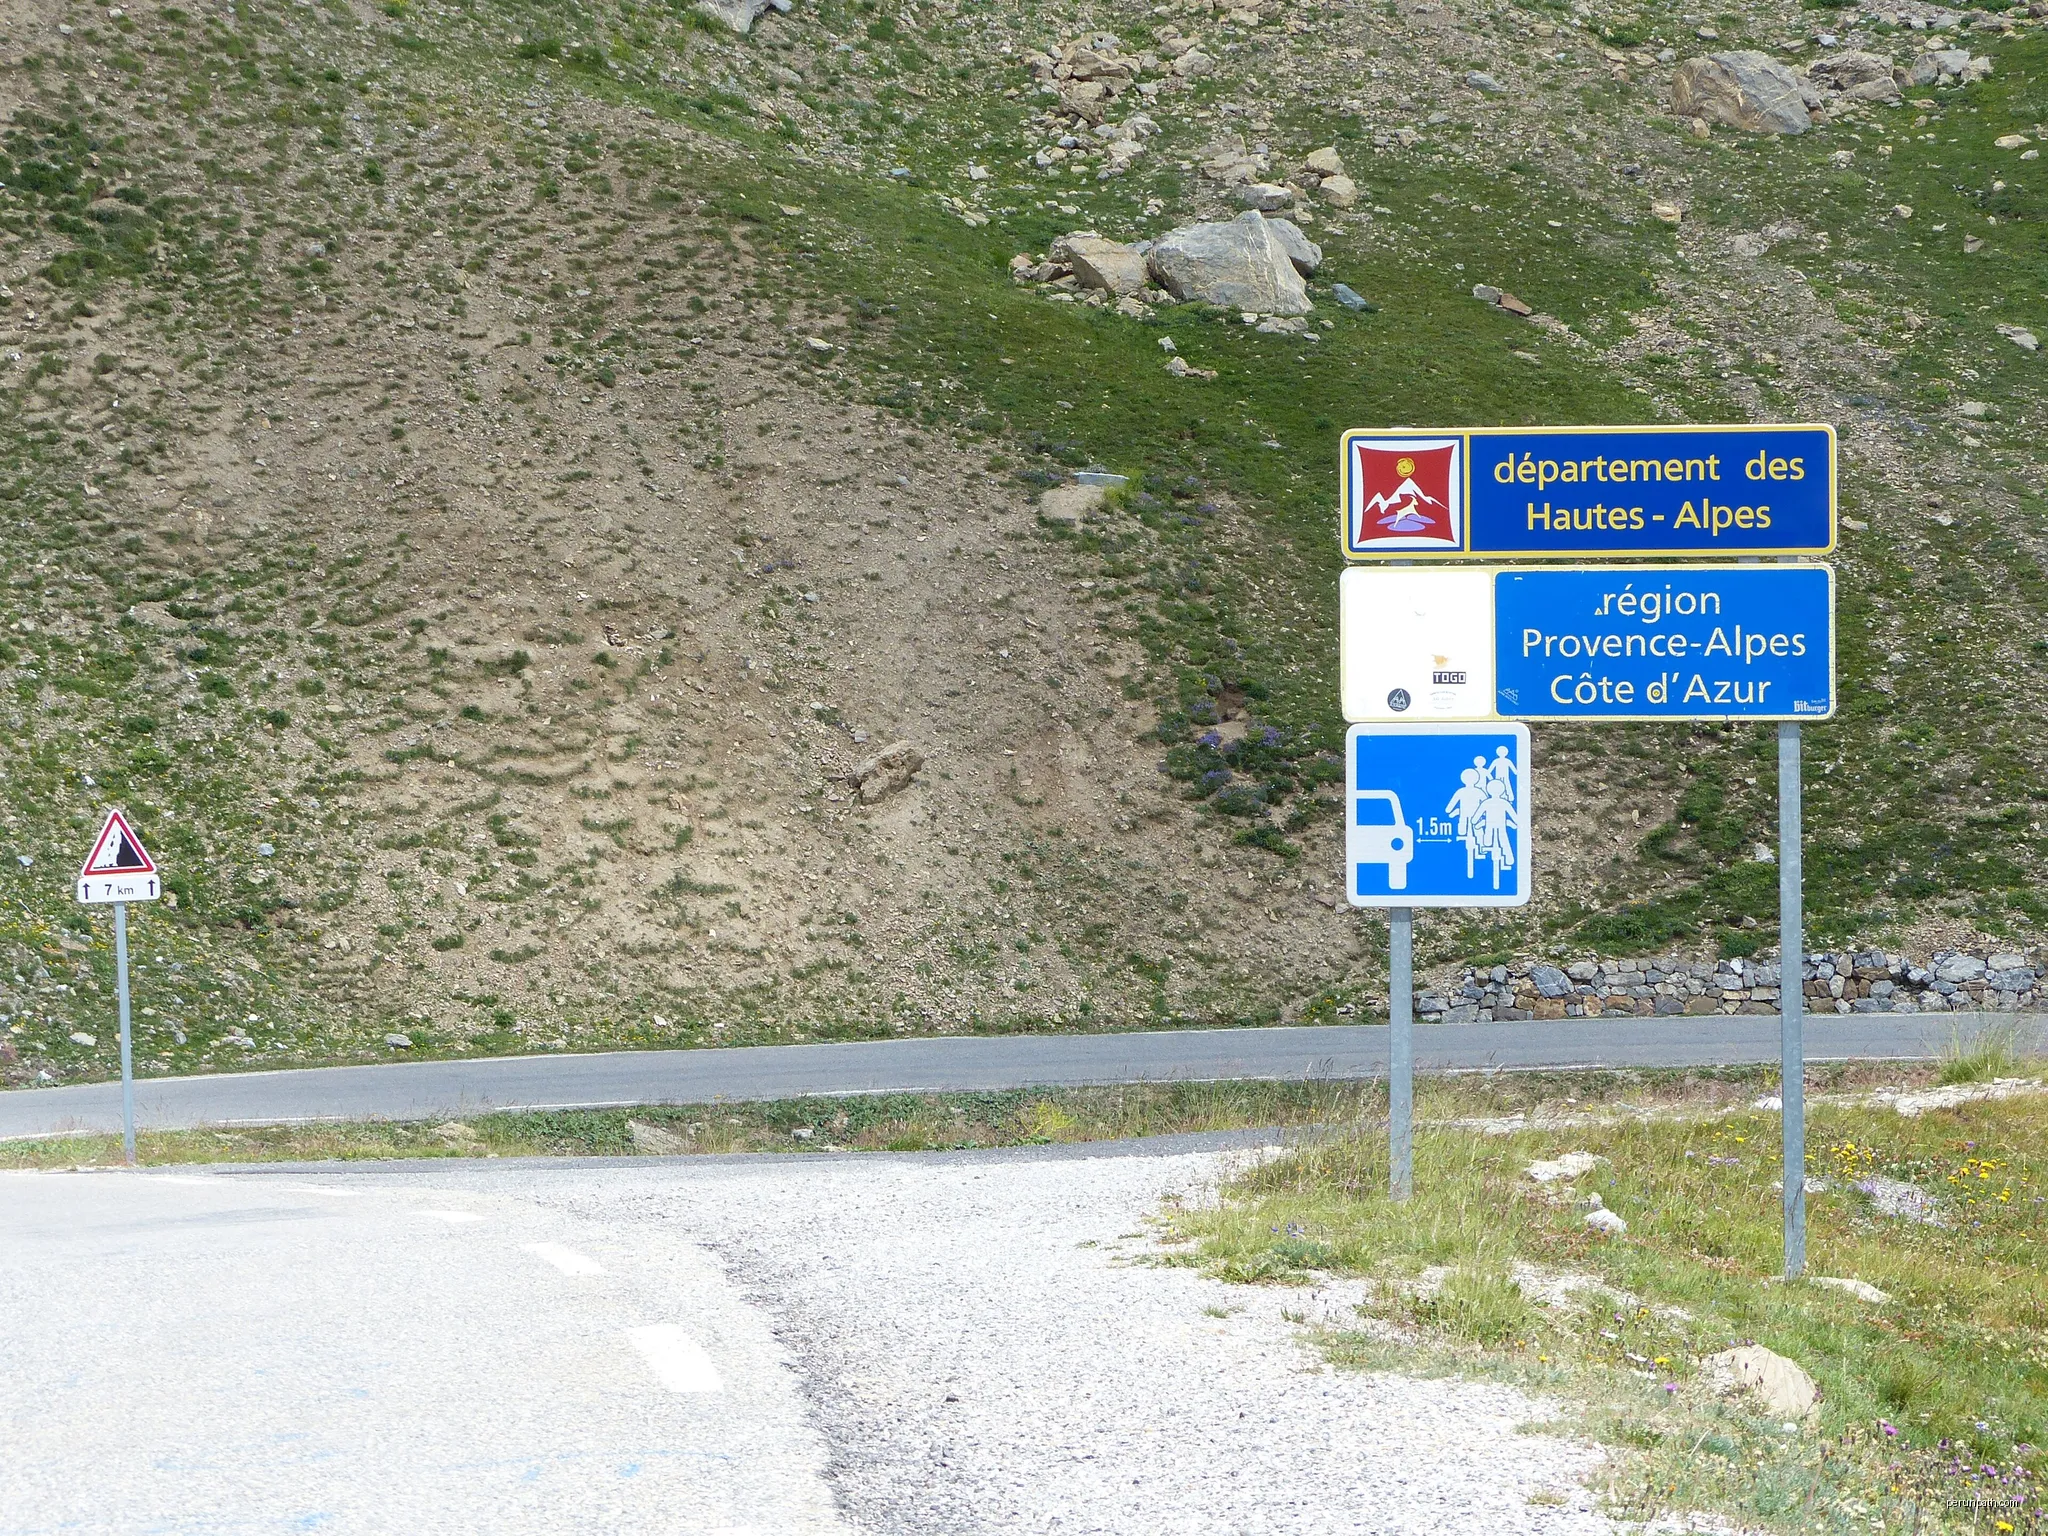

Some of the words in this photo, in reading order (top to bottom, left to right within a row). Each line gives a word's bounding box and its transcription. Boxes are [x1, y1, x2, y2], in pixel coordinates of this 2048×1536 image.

[1494, 451, 1720, 490] département
[1745, 450, 1805, 480] des
[1527, 502, 1645, 531] Hautes
[1673, 498, 1772, 536] Alpes
[1603, 584, 1720, 623] région
[1523, 624, 1807, 664] Provence-Alpes
[1433, 672, 1466, 684] TOGO
[1550, 671, 1635, 704] Côte
[1416, 817, 1452, 836] 1.5m
[105, 884, 112, 895] 7
[117, 886, 134, 895] km
